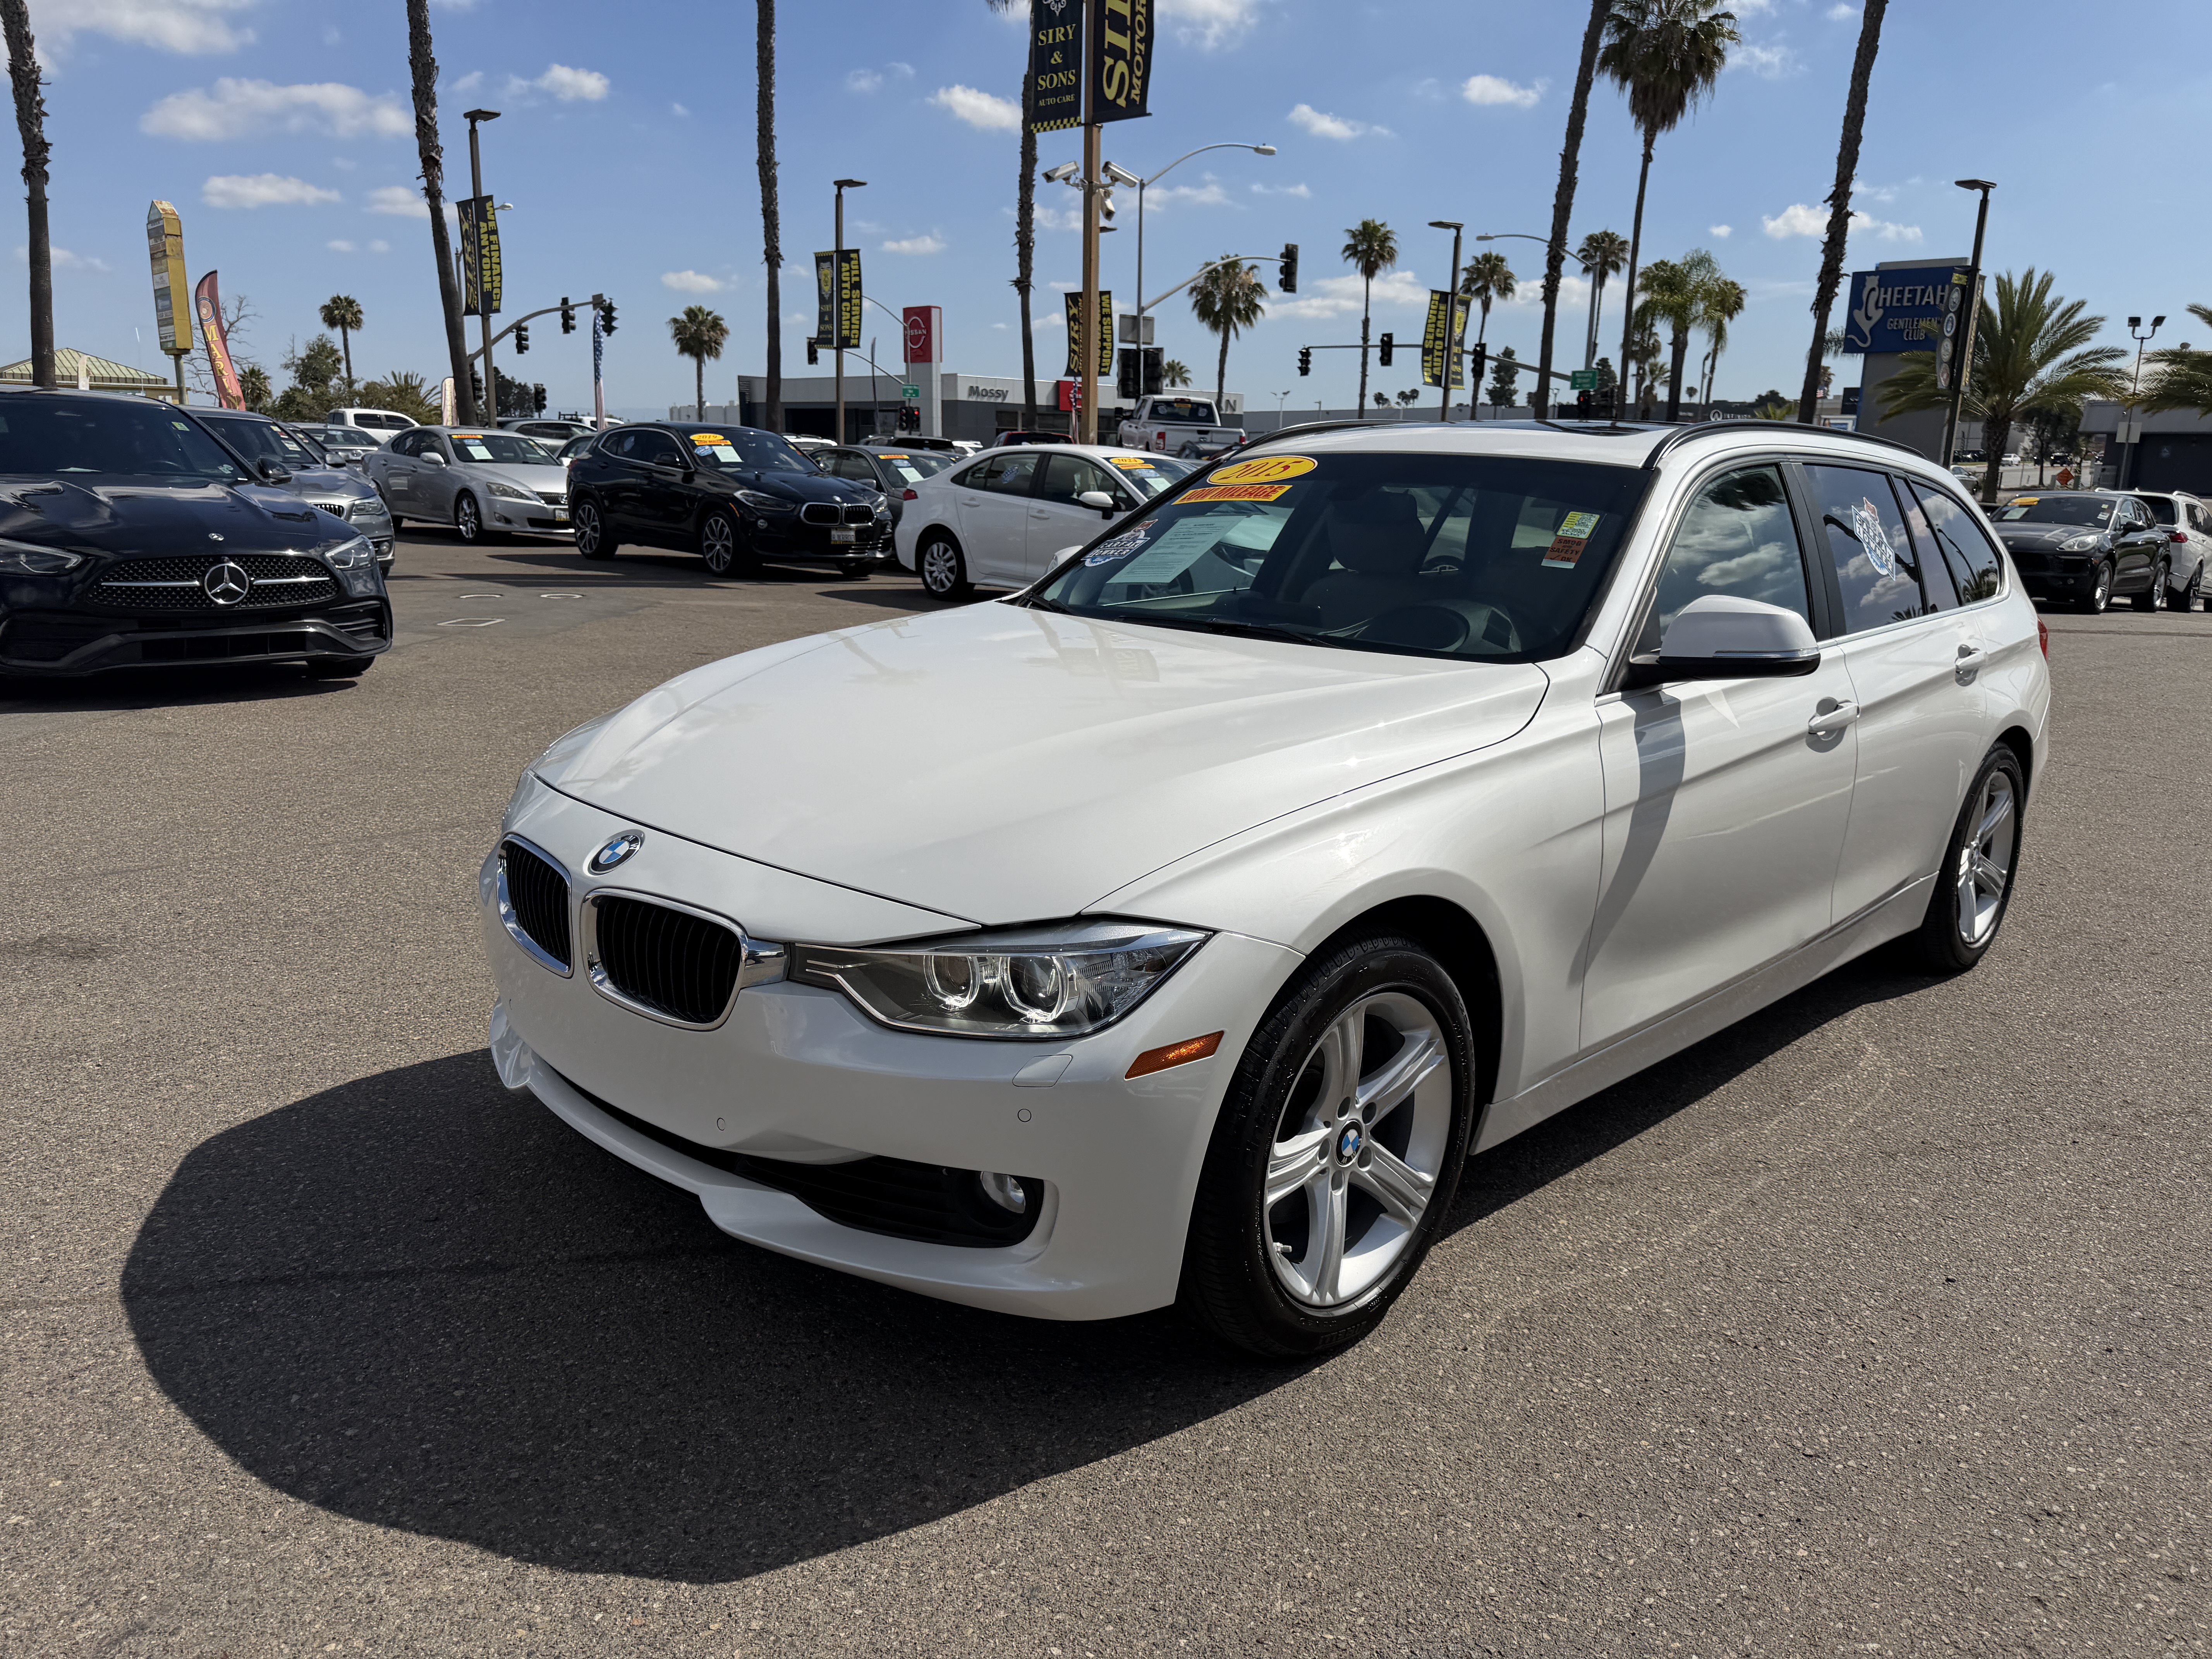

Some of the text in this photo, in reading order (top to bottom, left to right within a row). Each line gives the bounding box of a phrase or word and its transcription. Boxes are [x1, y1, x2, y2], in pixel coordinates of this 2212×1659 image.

[1038, 24, 1076, 46] SIRY
[1050, 51, 1063, 64] &
[1037, 70, 1075, 91] SONS
[1038, 94, 1075, 106] AUTO CARE
[479, 222, 492, 292] ANYONE
[486, 201, 501, 310] WE FINANCE
[841, 263, 851, 337] AUTO CARE
[850, 253, 860, 346] FULL SERVICE
[1101, 294, 1112, 374] WE SUPPORT
[1423, 293, 1440, 383] FULL SERVICE
[1432, 303, 1447, 376] AUTO CARE
[1903, 329, 1925, 340] CLUB
[968, 386, 1008, 402] Mossy
[1217, 461, 1305, 480] 2015
[1180, 485, 1286, 502] LOW MILEAGE
[1550, 547, 1580, 555] SAFETY
